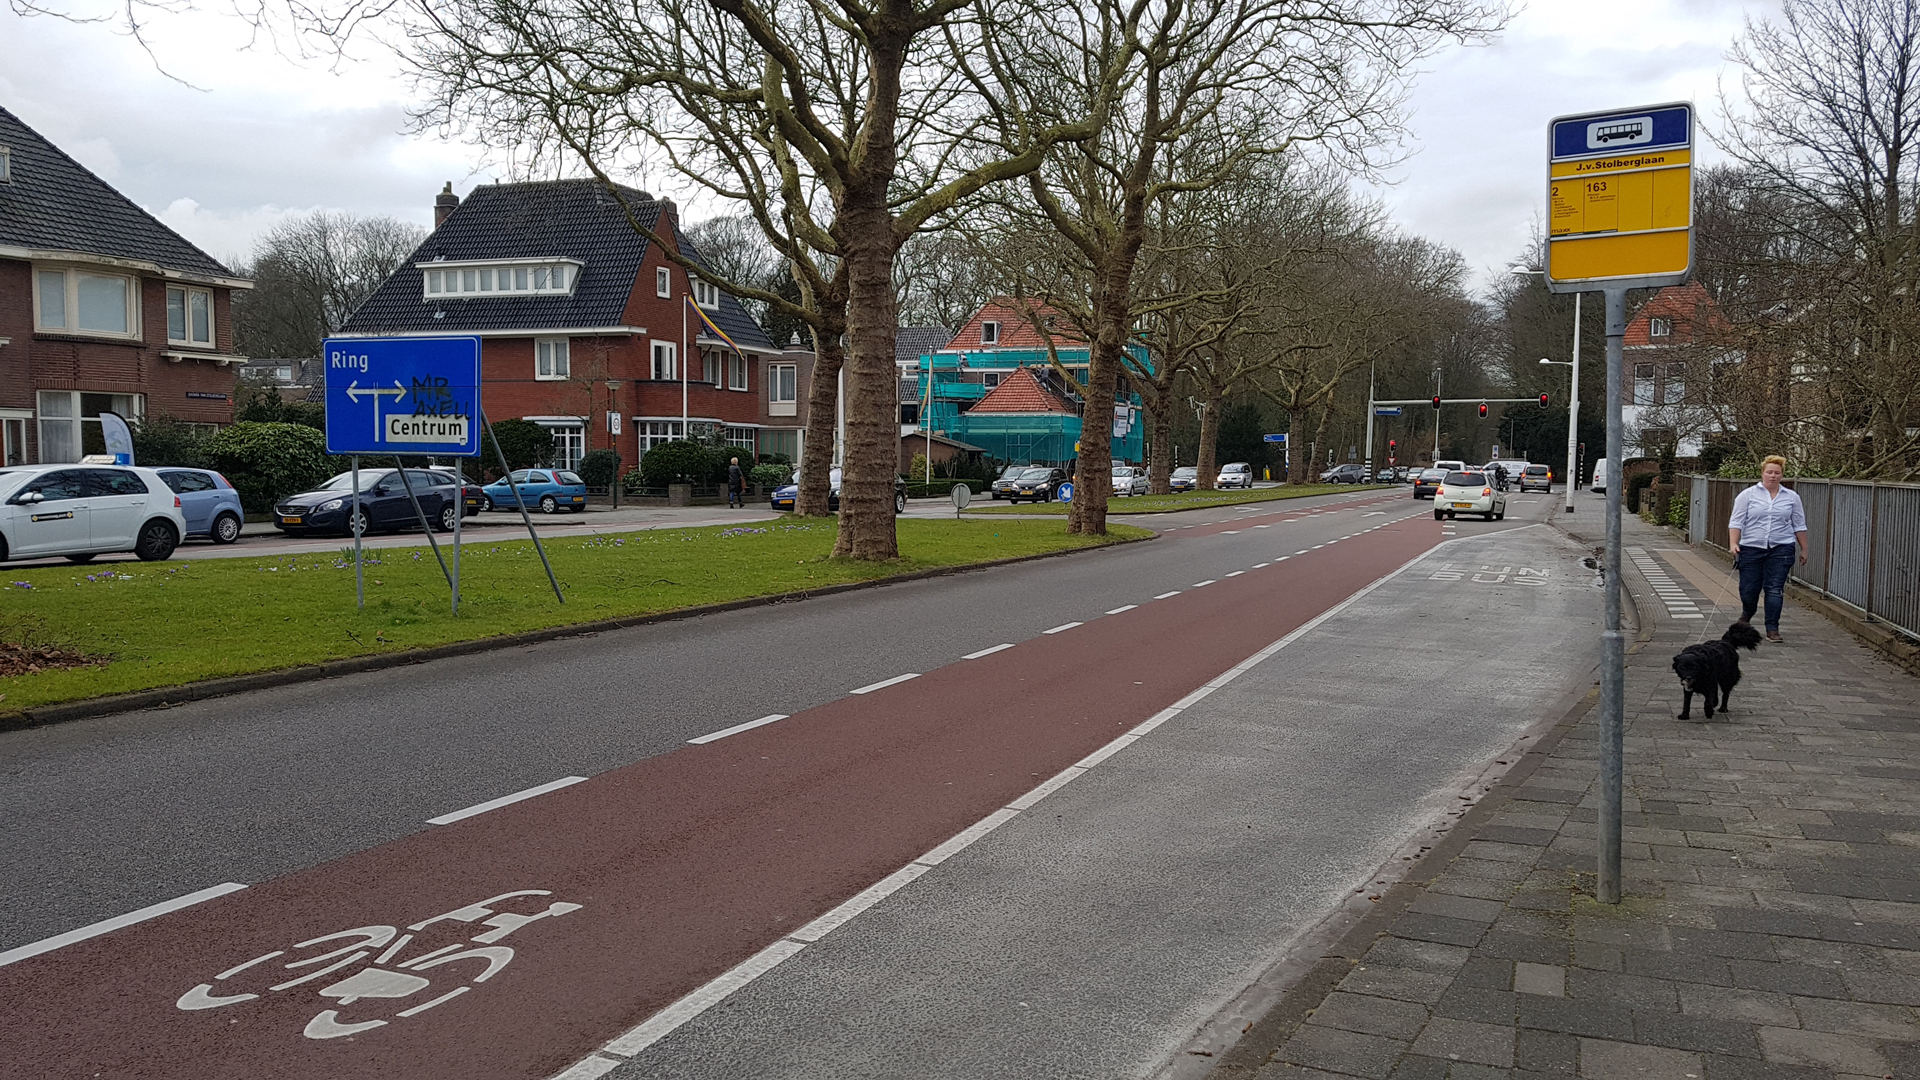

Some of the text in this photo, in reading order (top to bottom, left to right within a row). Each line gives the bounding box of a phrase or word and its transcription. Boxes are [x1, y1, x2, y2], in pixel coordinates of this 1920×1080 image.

[1576, 156, 1665, 171] J.v.Stolberglaan
[1552, 187, 1559, 197] 2
[1586, 181, 1607, 192] 163
[331, 351, 368, 373] Ring
[411, 373, 451, 404] MR
[391, 419, 462, 436] Centrum
[116, 455, 122, 463] L
